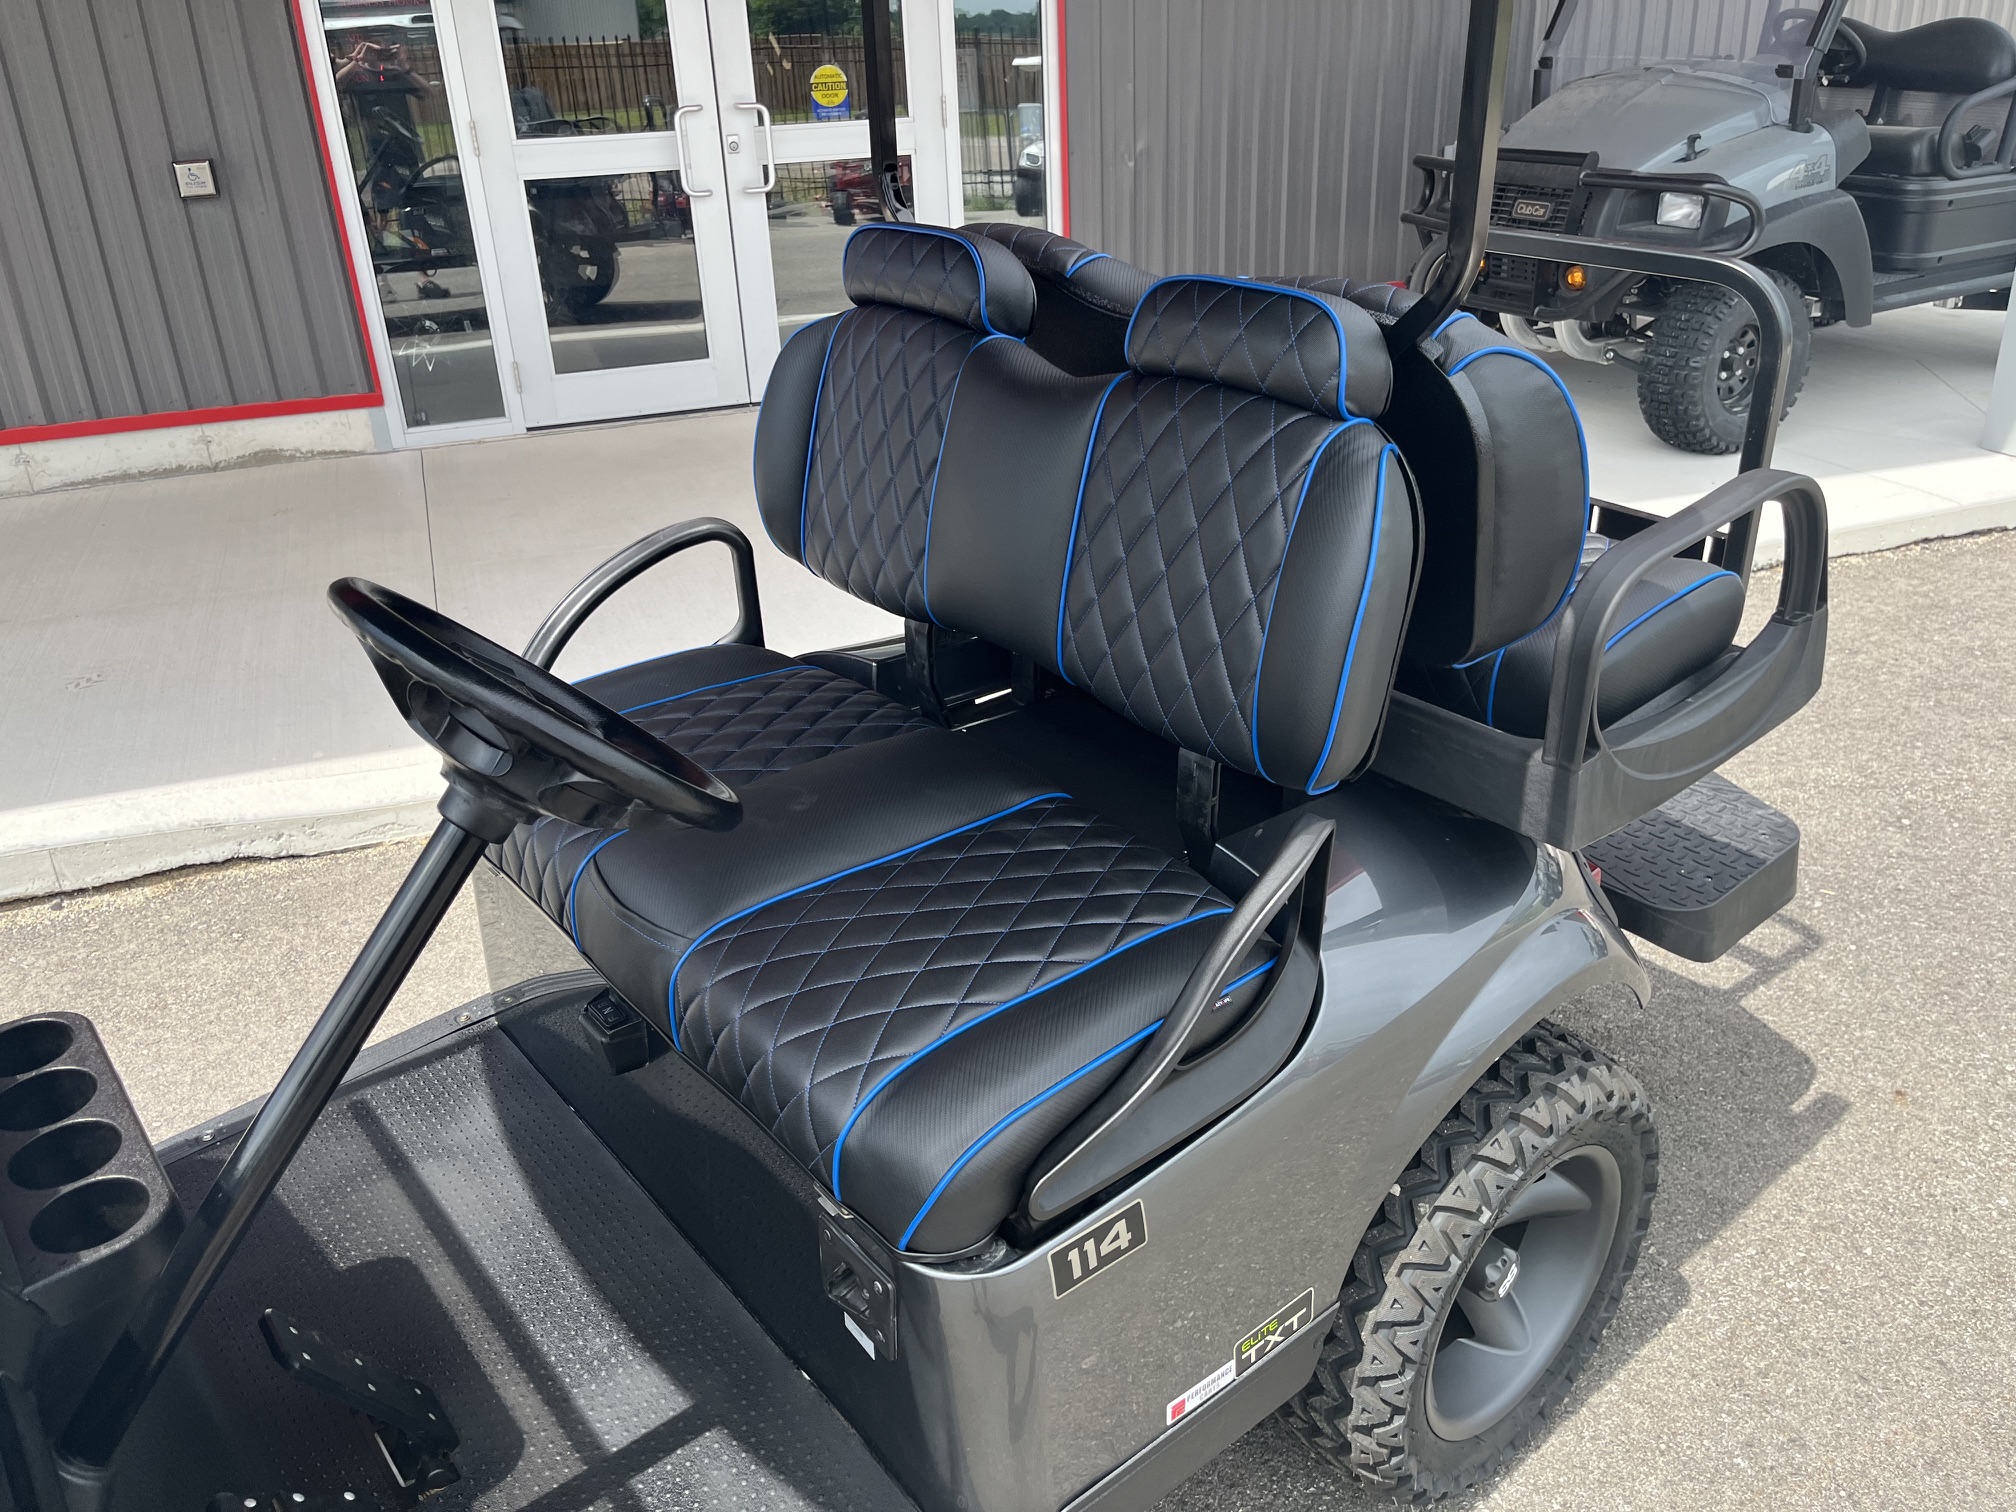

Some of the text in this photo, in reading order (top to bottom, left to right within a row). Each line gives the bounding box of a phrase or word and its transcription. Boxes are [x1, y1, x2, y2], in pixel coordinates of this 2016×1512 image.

[812, 82, 846, 91] CAUTION
[1789, 154, 1830, 181] 4x4
[1067, 1218, 1132, 1280] 114
[1241, 1307, 1307, 1364] TXT
[1186, 1364, 1233, 1402] PERFORMANCE
[1200, 1381, 1220, 1401] CARTS
